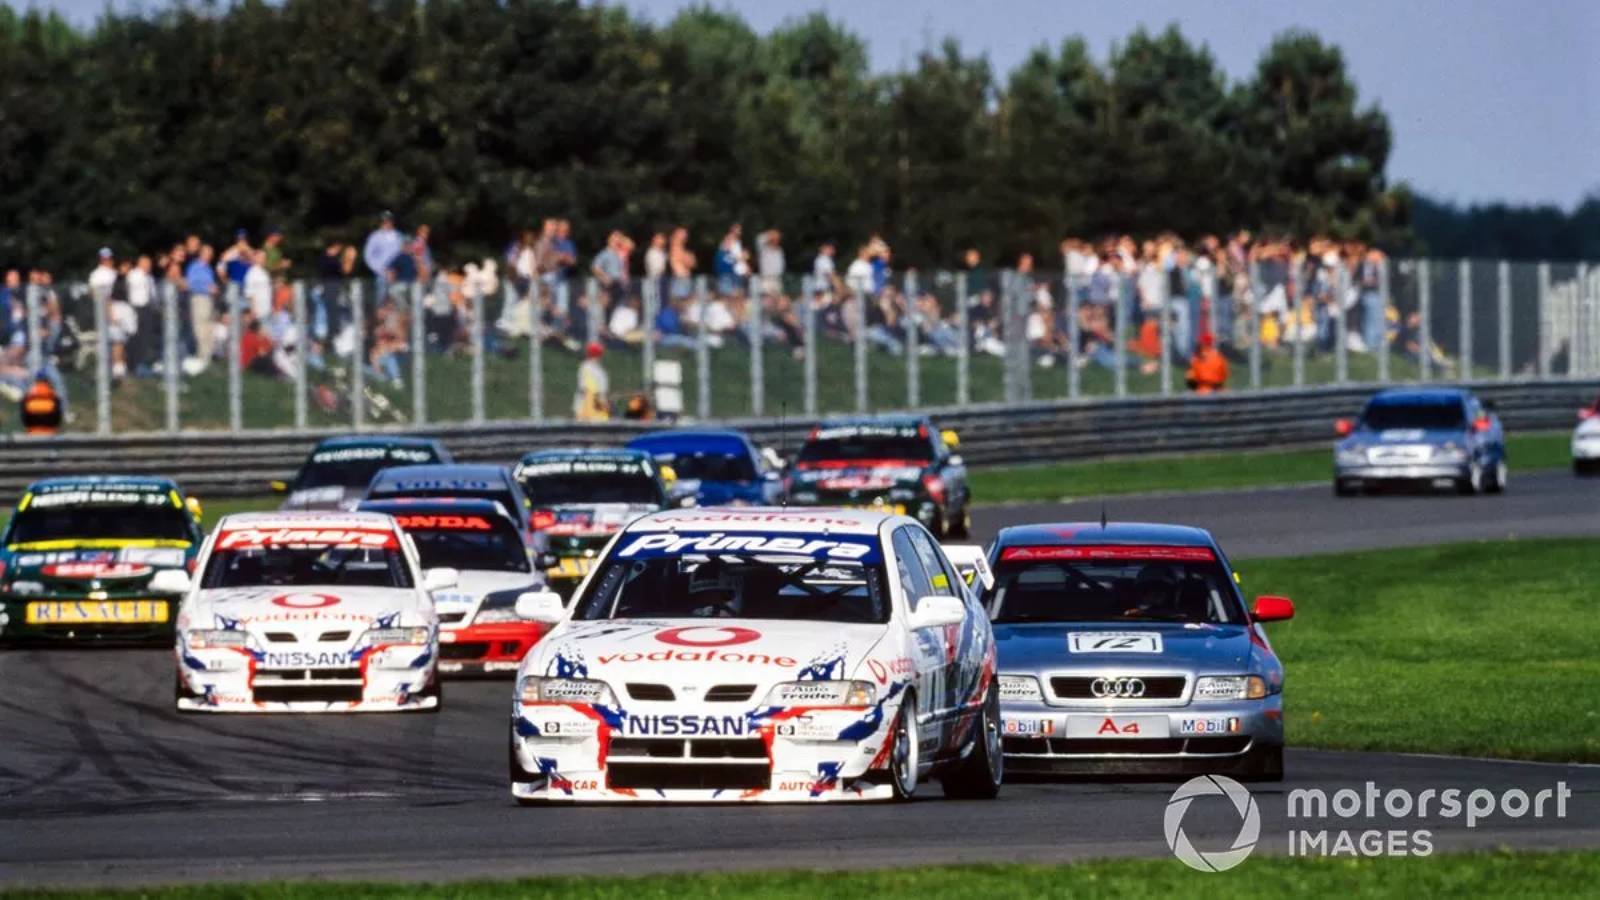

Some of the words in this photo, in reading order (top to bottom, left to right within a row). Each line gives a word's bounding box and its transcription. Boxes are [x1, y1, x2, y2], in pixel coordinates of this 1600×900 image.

[396, 481, 489, 490] VOLVO
[395, 516, 492, 529] ONDA
[652, 514, 861, 527] vodafone
[219, 529, 390, 548] Primera
[618, 532, 872, 557] Primera
[36, 603, 158, 620] RENAULT
[1092, 637, 1142, 649] 12
[268, 652, 347, 666] NISSAN
[597, 650, 797, 668] vodafone
[548, 689, 601, 697] Trader
[629, 715, 744, 736] NISSAN
[1096, 718, 1141, 735] A4
[1182, 719, 1225, 732] Mobil
